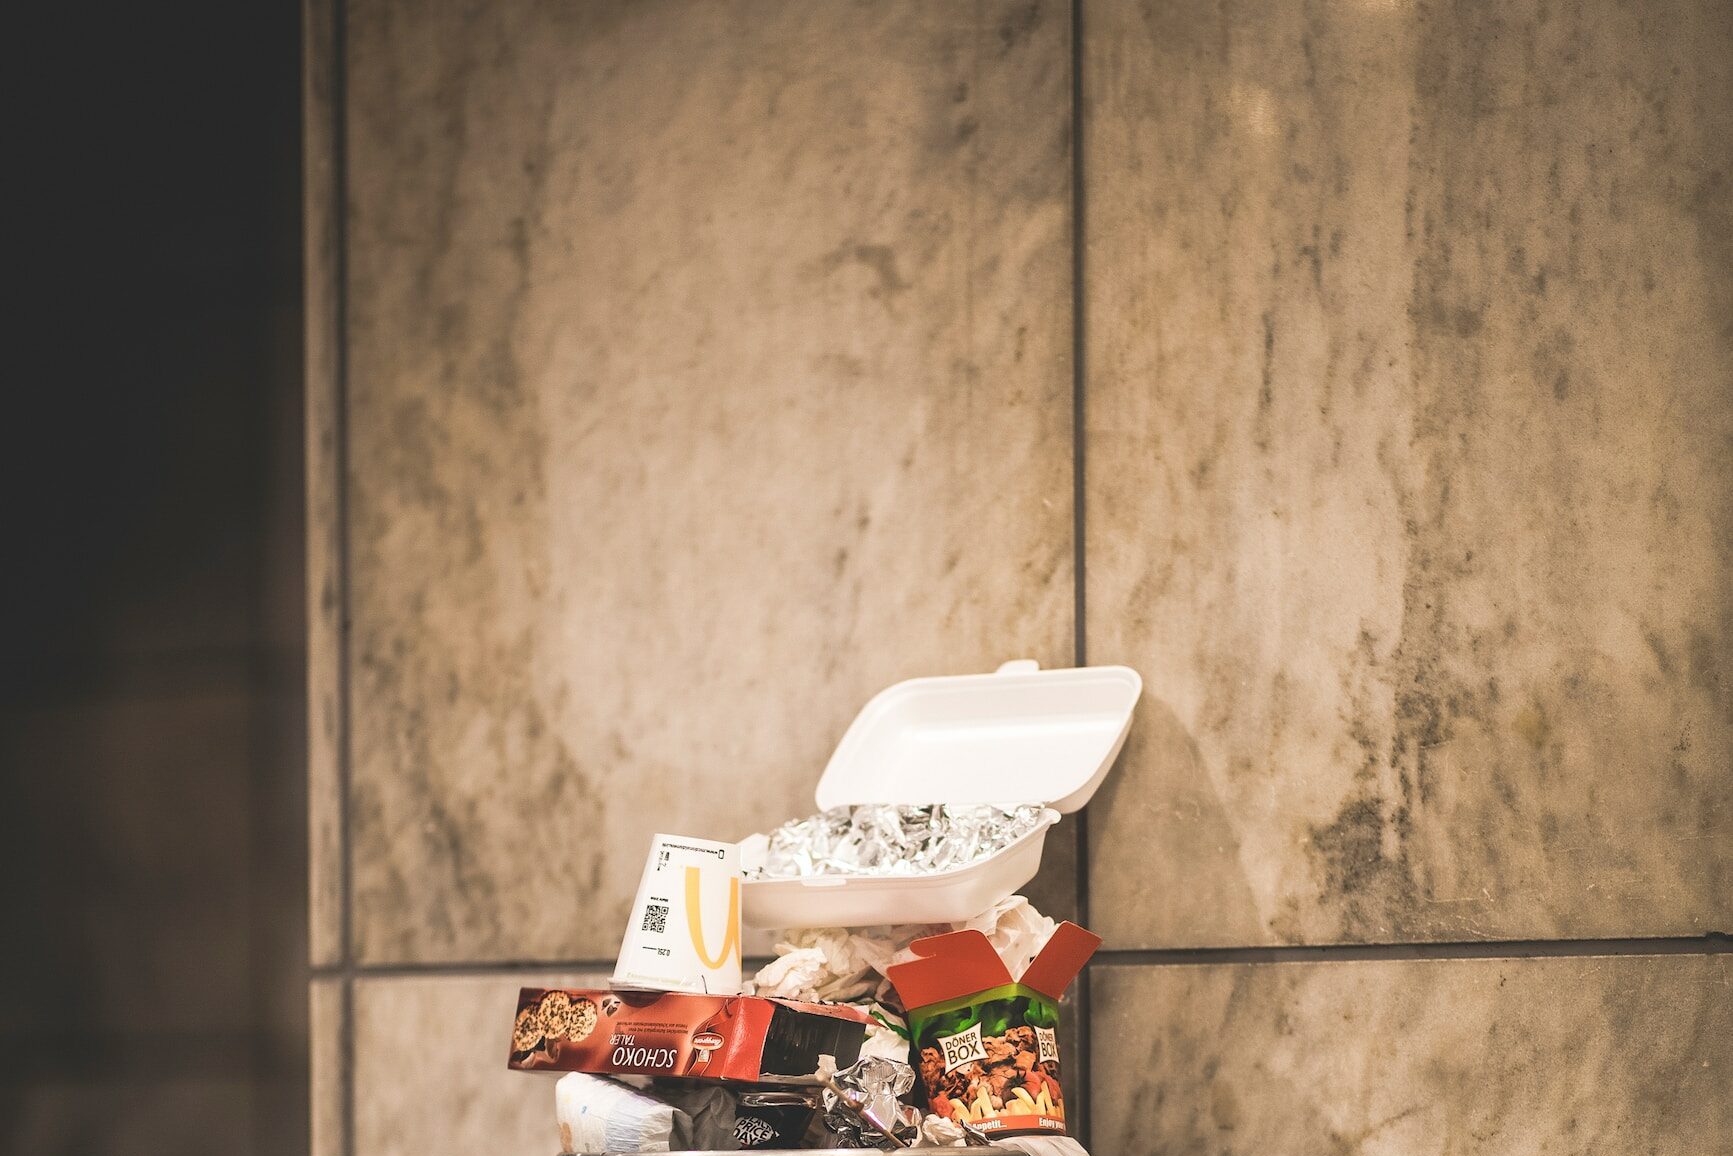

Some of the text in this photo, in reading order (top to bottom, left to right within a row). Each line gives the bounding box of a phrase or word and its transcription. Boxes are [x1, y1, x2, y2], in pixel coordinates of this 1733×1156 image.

[609, 1033, 636, 1045] TALER
[945, 1032, 977, 1050] DÖNER
[612, 1047, 677, 1068] SCHOKO
[948, 1041, 980, 1065] BOX
[1041, 1042, 1056, 1057] BOX
[735, 1119, 770, 1140] PRICE
[1039, 1117, 1055, 1128] Enjoy
